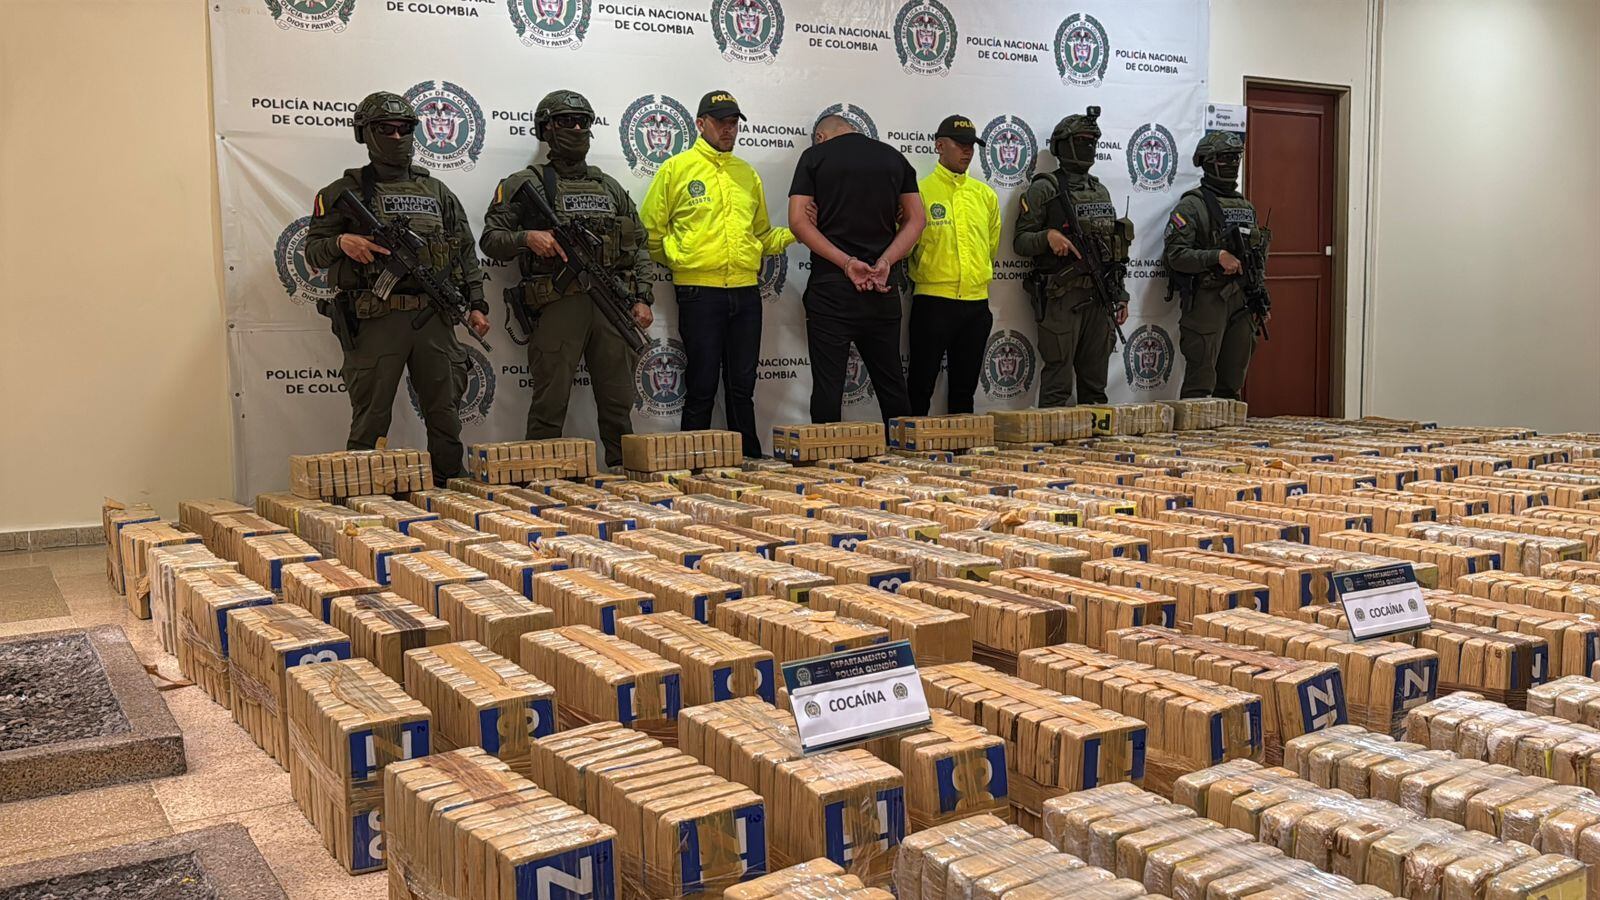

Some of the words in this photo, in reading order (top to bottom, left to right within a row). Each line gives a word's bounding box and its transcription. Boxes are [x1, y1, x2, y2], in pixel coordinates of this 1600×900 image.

[280, 0, 303, 19] OLICIA
[387, 1, 404, 12] DE
[408, 3, 479, 17] COLOMBIA
[598, 4, 645, 17] POLICÍA
[648, 8, 709, 23] NACIONAL
[311, 20, 337, 30] PATRIA
[614, 20, 630, 30] DE
[633, 22, 695, 35] COLOMBIA
[795, 23, 836, 35] POLICÍA
[838, 27, 891, 40] NACIONAL
[809, 38, 823, 47] DE
[825, 40, 879, 52] COLOMBIA
[966, 36, 1002, 48] POLICÍA
[1003, 41, 1050, 52] NACIONAL
[978, 50, 990, 60] DE
[992, 51, 1038, 63] COLOMBIA
[1115, 49, 1147, 60] POLICÍA
[1149, 53, 1188, 64] NACIONAL
[1125, 62, 1136, 71] DE
[1137, 64, 1179, 75] COLOMBIA
[252, 97, 308, 110] POLICÍA
[312, 101, 358, 112] NACIO
[271, 114, 291, 125] DE
[294, 115, 354, 127] COLOMB
[492, 109, 535, 122] POLICÍ
[509, 126, 526, 136] DE
[752, 124, 808, 136] NACIONAL
[888, 130, 926, 142] POLICÍA
[738, 137, 794, 148] COLOMBIA
[413, 141, 435, 160] OLICIA
[900, 145, 915, 154] DE
[442, 159, 466, 169] PATRIA
[384, 196, 436, 207] COMANDO
[390, 202, 434, 213] JUNGLA
[570, 203, 609, 211] JUNGLA
[757, 357, 810, 368] NACIONAL
[266, 367, 323, 379] POLICÍA
[502, 365, 529, 374] POLI
[286, 384, 304, 394] DE
[308, 383, 348, 393] COLO
[519, 379, 535, 388] DE
[1369, 602, 1405, 618] COCAÍNA
[830, 651, 888, 669] DEPARTAMENTO
[888, 650, 897, 658] DE
[835, 666, 864, 679] POLICÍA
[865, 660, 898, 672] QUINDÍO
[829, 690, 887, 713] COCAÍNA
